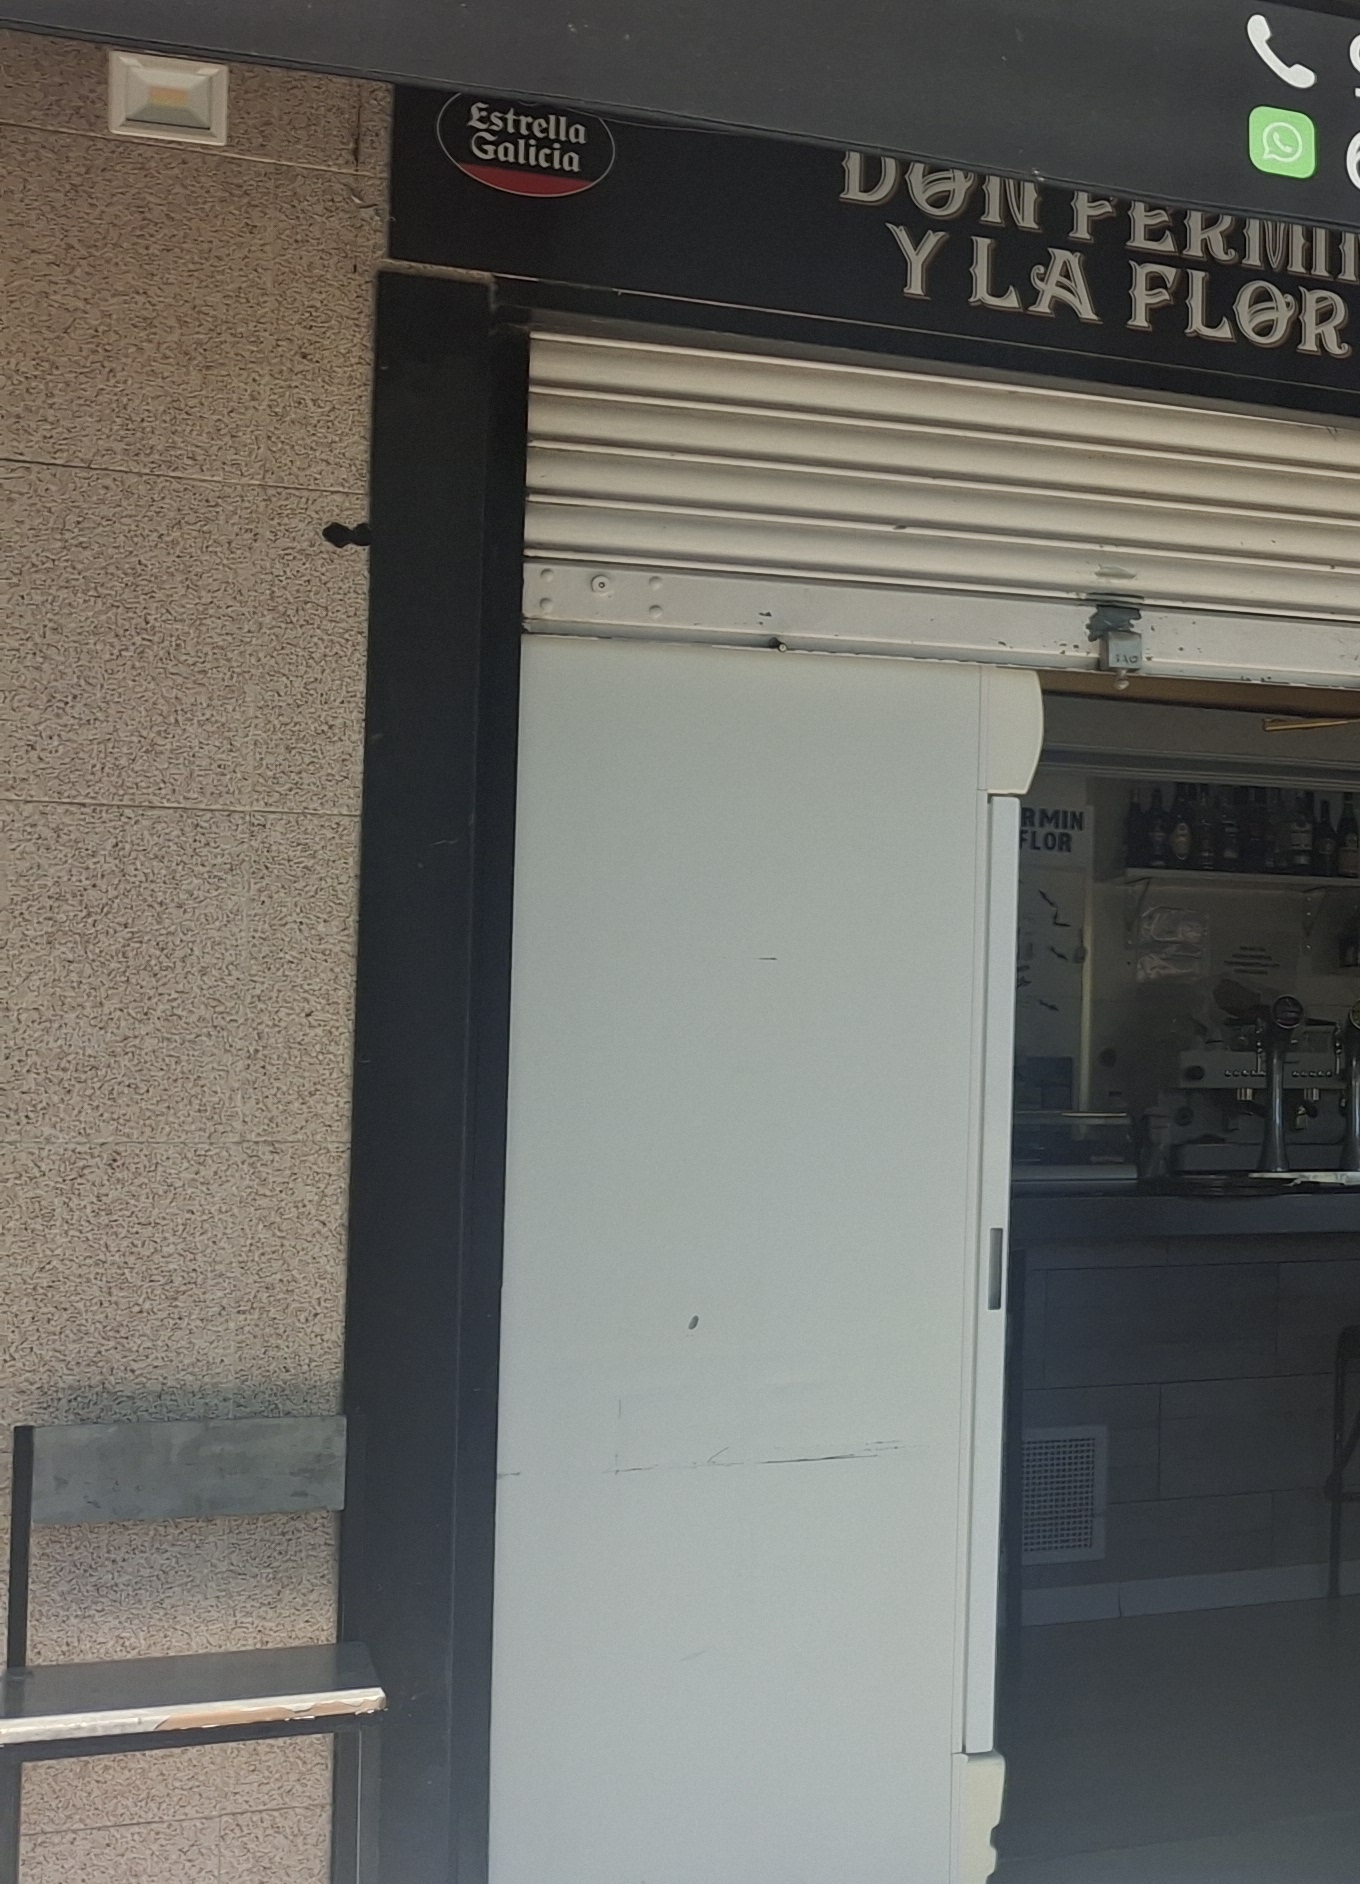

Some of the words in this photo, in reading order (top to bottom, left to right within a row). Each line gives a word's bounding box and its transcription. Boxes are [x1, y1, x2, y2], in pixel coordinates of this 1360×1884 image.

[467, 102, 587, 145] Estrella
[470, 131, 581, 173] Galicia
[839, 150, 1043, 232] DON
[884, 222, 949, 299] Y
[967, 234, 1103, 325] LA
[1125, 259, 1353, 359] FLOR
[1020, 806, 1085, 832] RMIN
